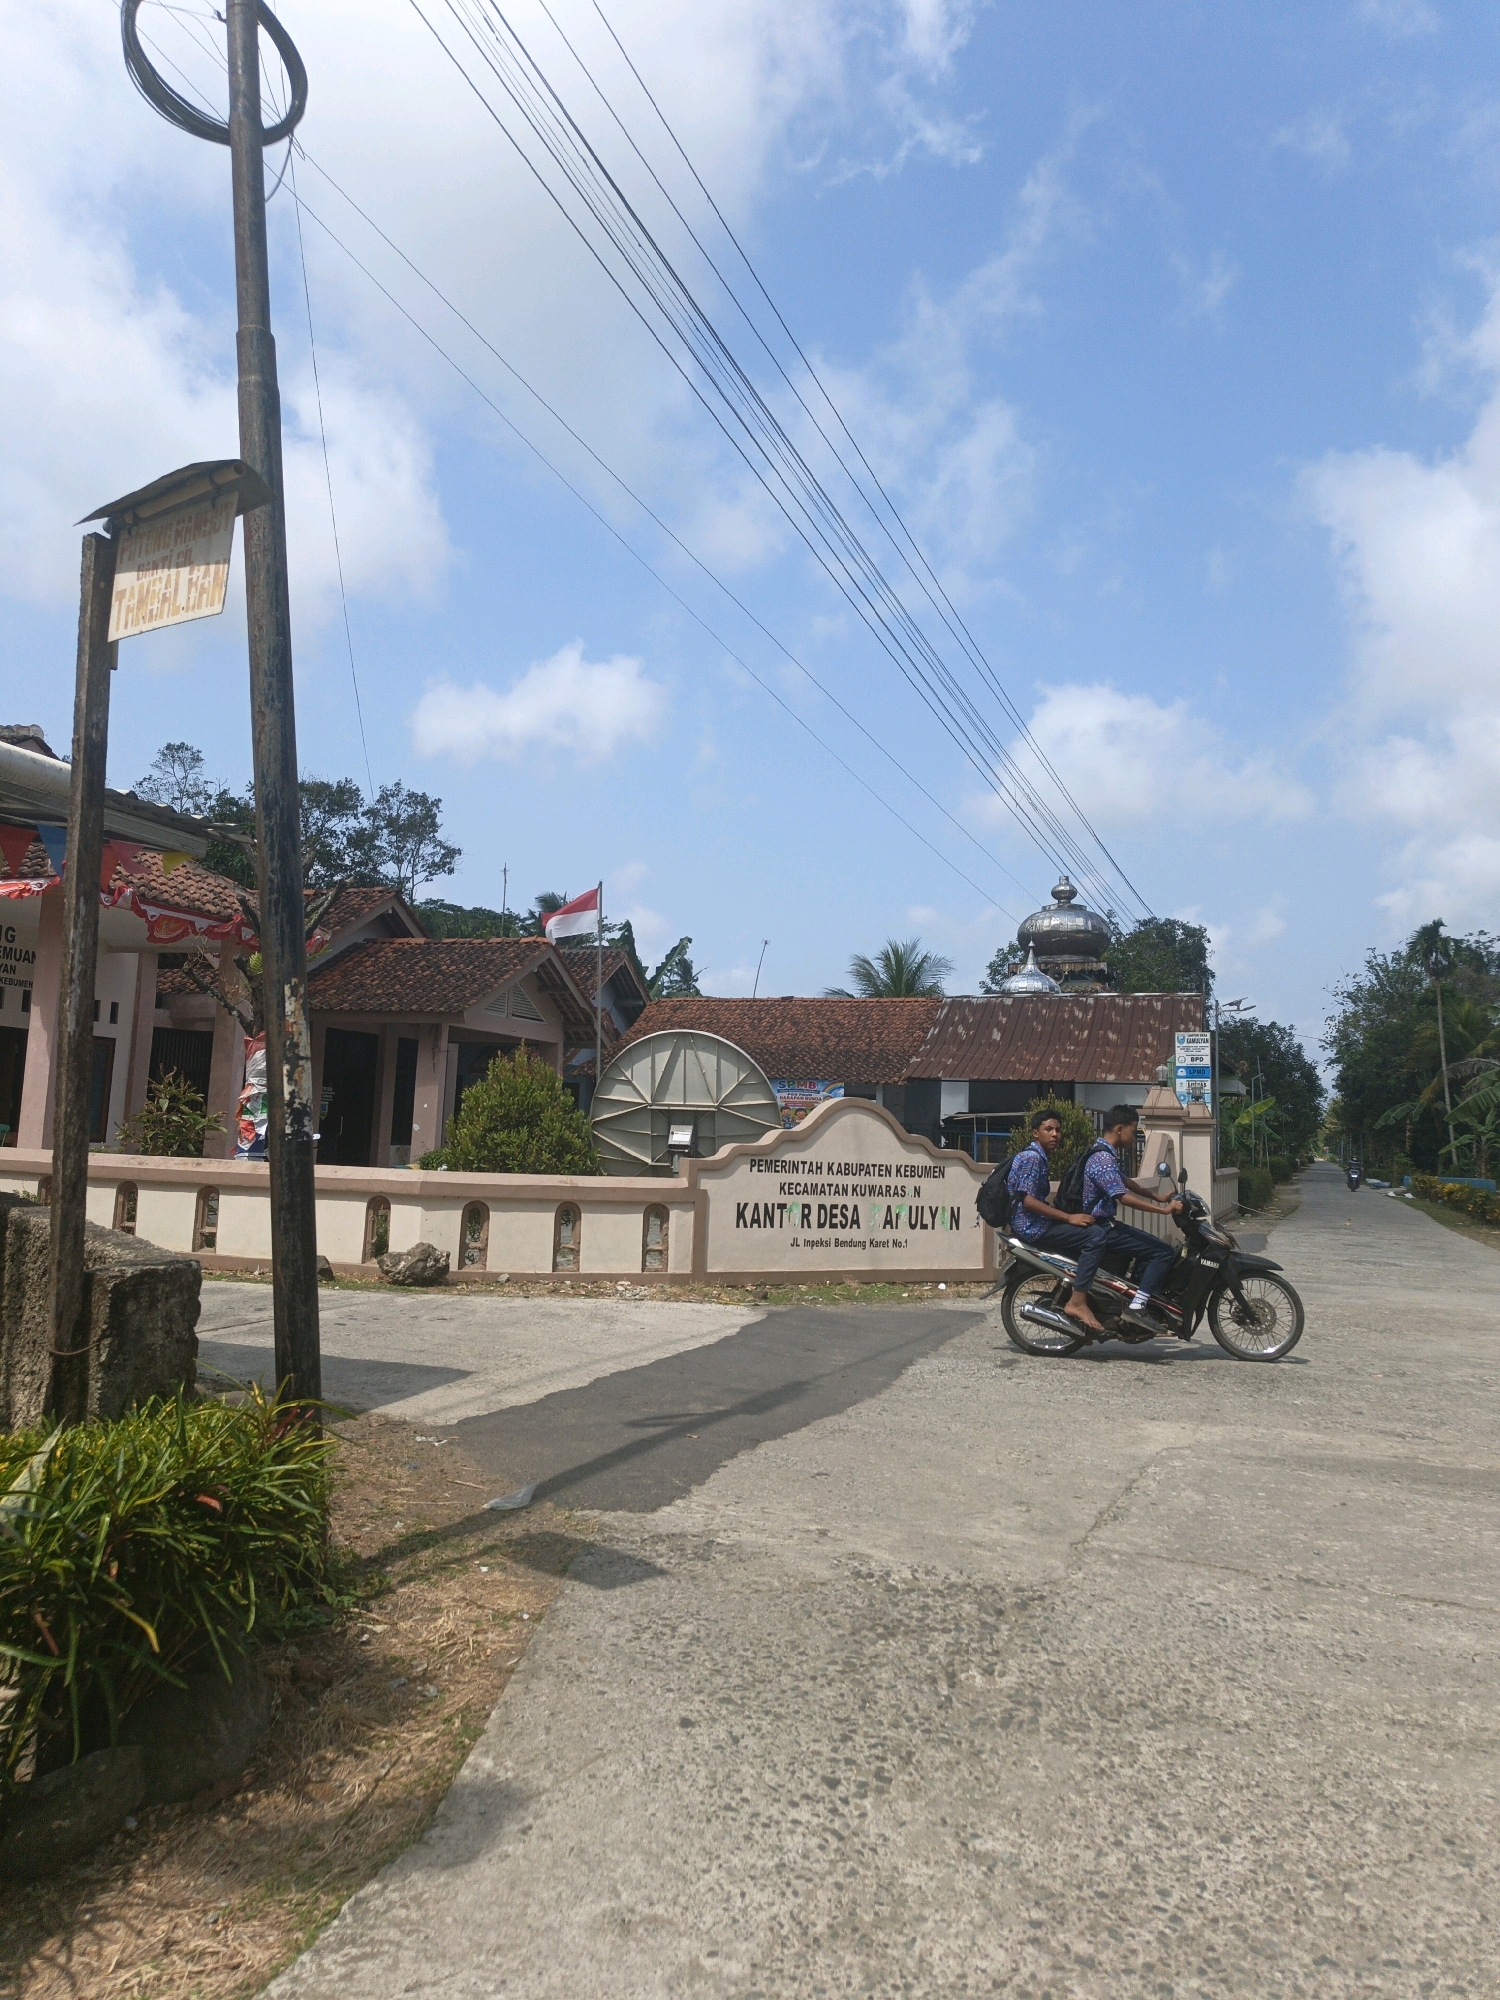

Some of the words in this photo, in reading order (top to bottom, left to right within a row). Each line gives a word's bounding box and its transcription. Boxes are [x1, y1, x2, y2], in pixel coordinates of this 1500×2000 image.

[778, 1080, 817, 1090] SPMB
[749, 1158, 823, 1175] PEMERINTAH
[827, 1162, 892, 1178] KABUPATEN
[895, 1164, 946, 1179] KEBUMEN
[779, 1182, 849, 1197] KECAMATAN
[851, 1183, 921, 1198] KUWARASN
[817, 1203, 861, 1230] DESA
[790, 1237, 800, 1248] JL
[803, 1237, 832, 1250] Inpeksi
[834, 1237, 867, 1251] Bendung
[869, 1238, 890, 1249] Karet
[892, 1238, 908, 1249] No.1
